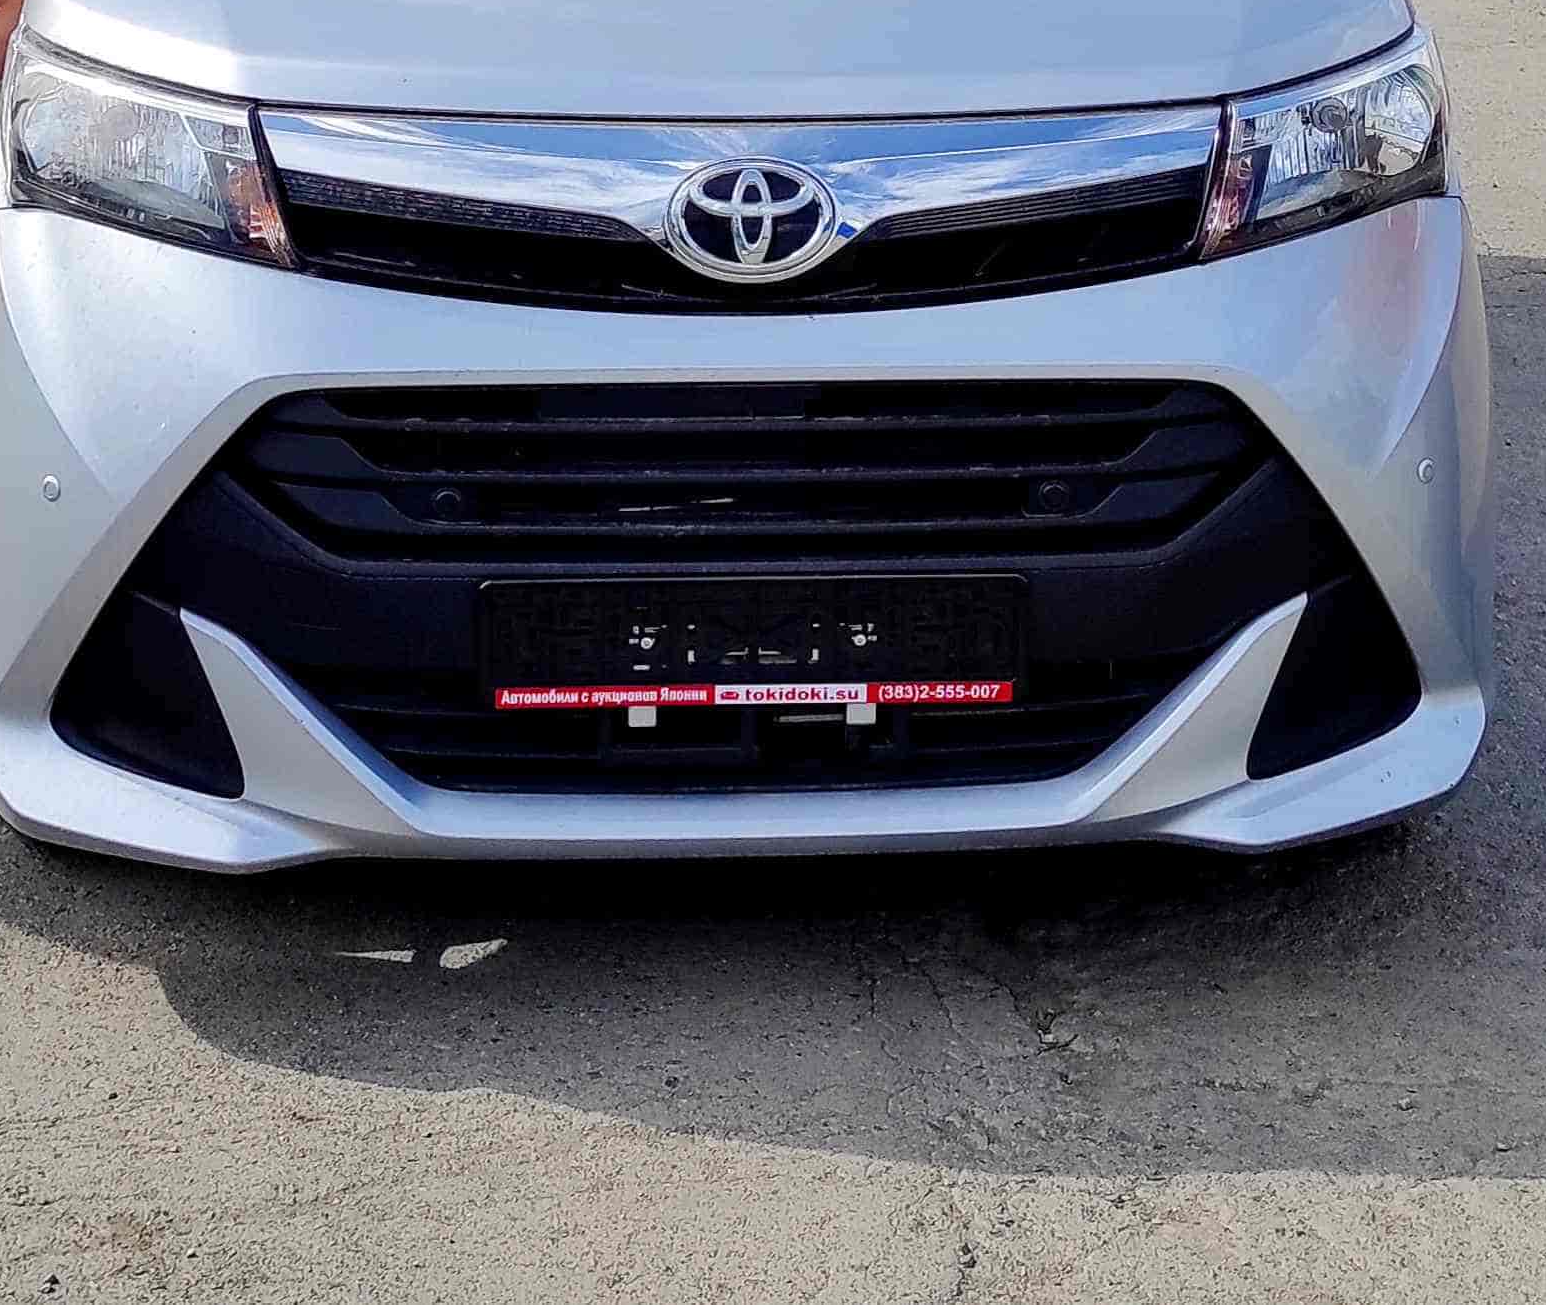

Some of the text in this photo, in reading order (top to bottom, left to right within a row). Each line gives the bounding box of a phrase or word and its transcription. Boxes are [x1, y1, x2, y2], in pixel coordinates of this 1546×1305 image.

[501, 687, 708, 706] Автомобили с аукционов Японии
[745, 684, 1002, 703] tokidoki.su (383)2-555-007
